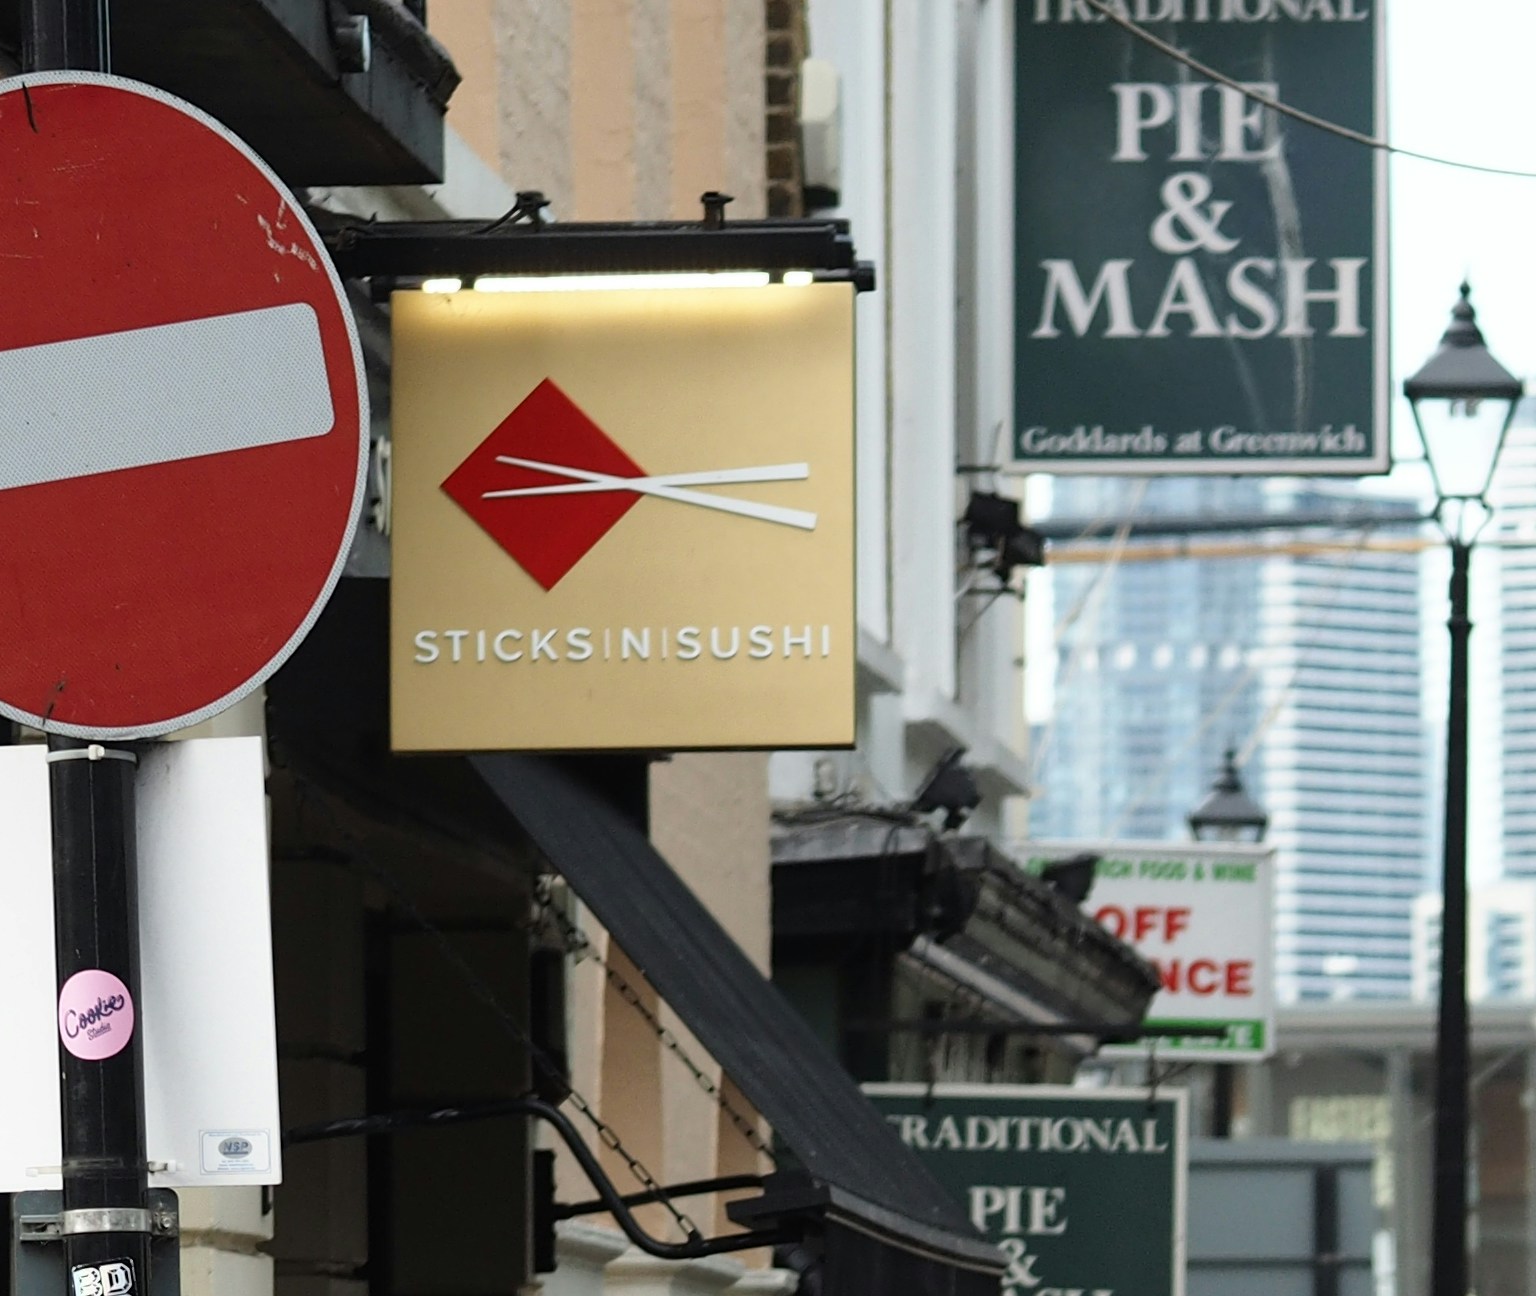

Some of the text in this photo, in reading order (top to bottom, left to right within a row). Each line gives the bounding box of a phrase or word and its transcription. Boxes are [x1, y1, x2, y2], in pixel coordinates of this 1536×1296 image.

[1109, 82, 1283, 162] PIE
[1150, 172, 1241, 254] &
[1030, 257, 1368, 339] MASH
[1020, 425, 1366, 455] Goddards at Greenwich
[1095, 904, 1191, 943] OFF
[224, 1141, 249, 1153] NSP
[969, 1186, 1067, 1235] PIE
